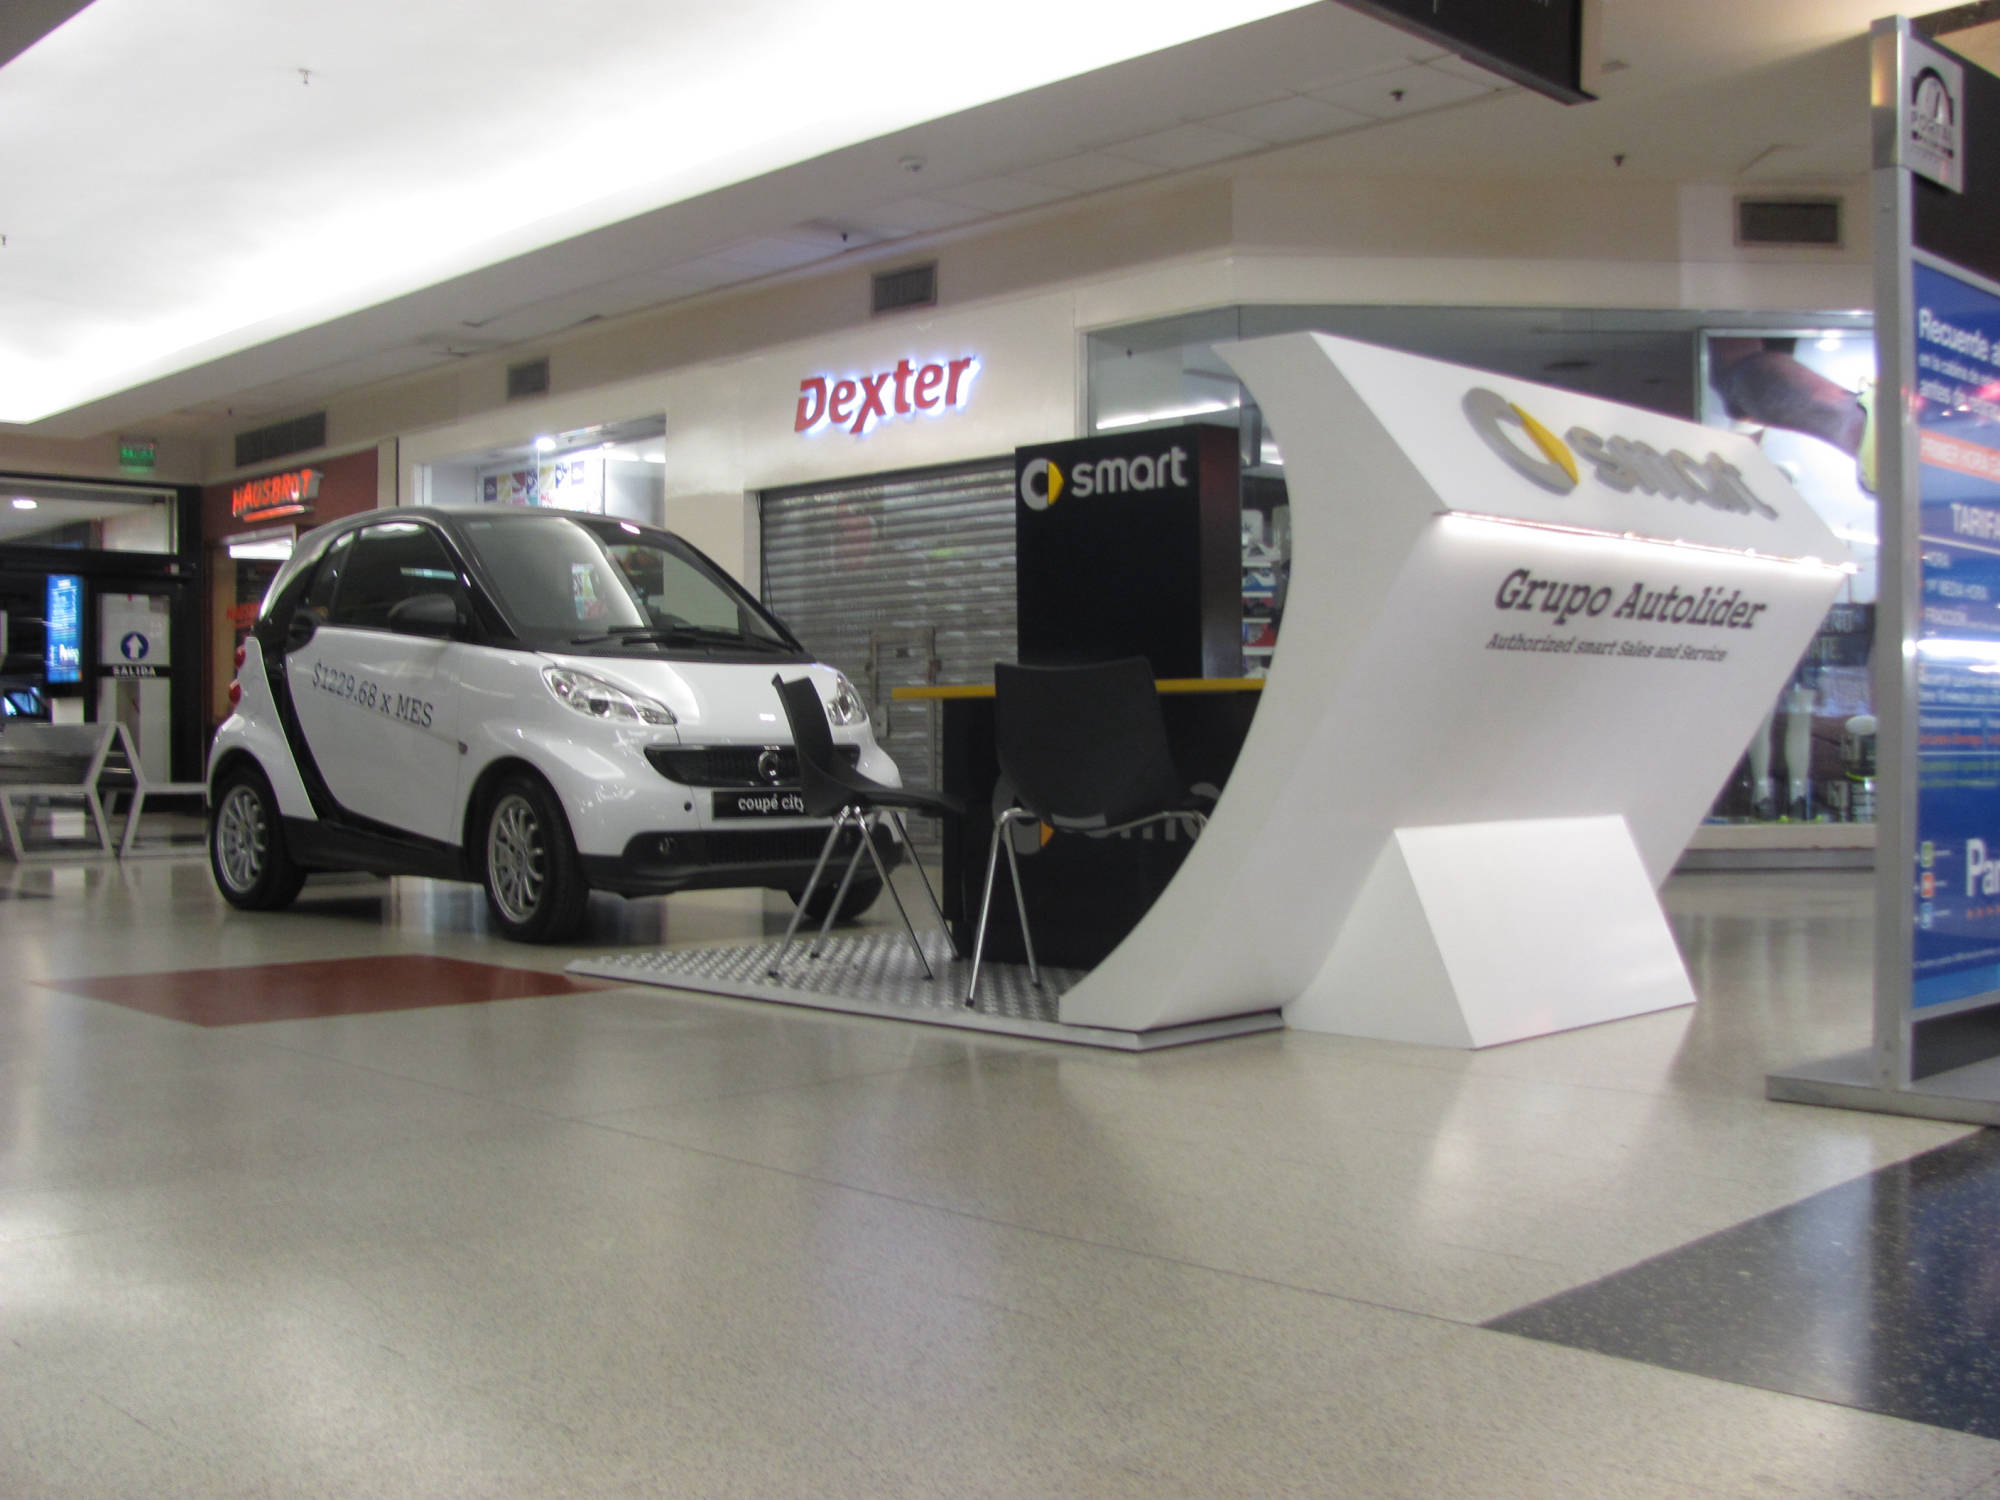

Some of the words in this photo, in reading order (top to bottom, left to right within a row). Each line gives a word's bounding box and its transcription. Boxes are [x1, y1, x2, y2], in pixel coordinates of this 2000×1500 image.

[794, 357, 972, 434] Dexter
[233, 469, 312, 515] HAUSBROT
[1071, 446, 1187, 497] smart
[1564, 426, 1779, 521] smart
[1495, 568, 1612, 625] Grupo
[112, 665, 157, 678] SALIDA
[1486, 633, 1574, 653] Authorized
[1575, 640, 1616, 655] smart
[1617, 640, 1654, 657] Sales
[1654, 643, 1680, 659] and
[1680, 645, 1728, 661] Service
[312, 659, 377, 709] $1229.68
[380, 692, 392, 714] x
[396, 693, 434, 729] MES
[738, 793, 778, 813] coupé
